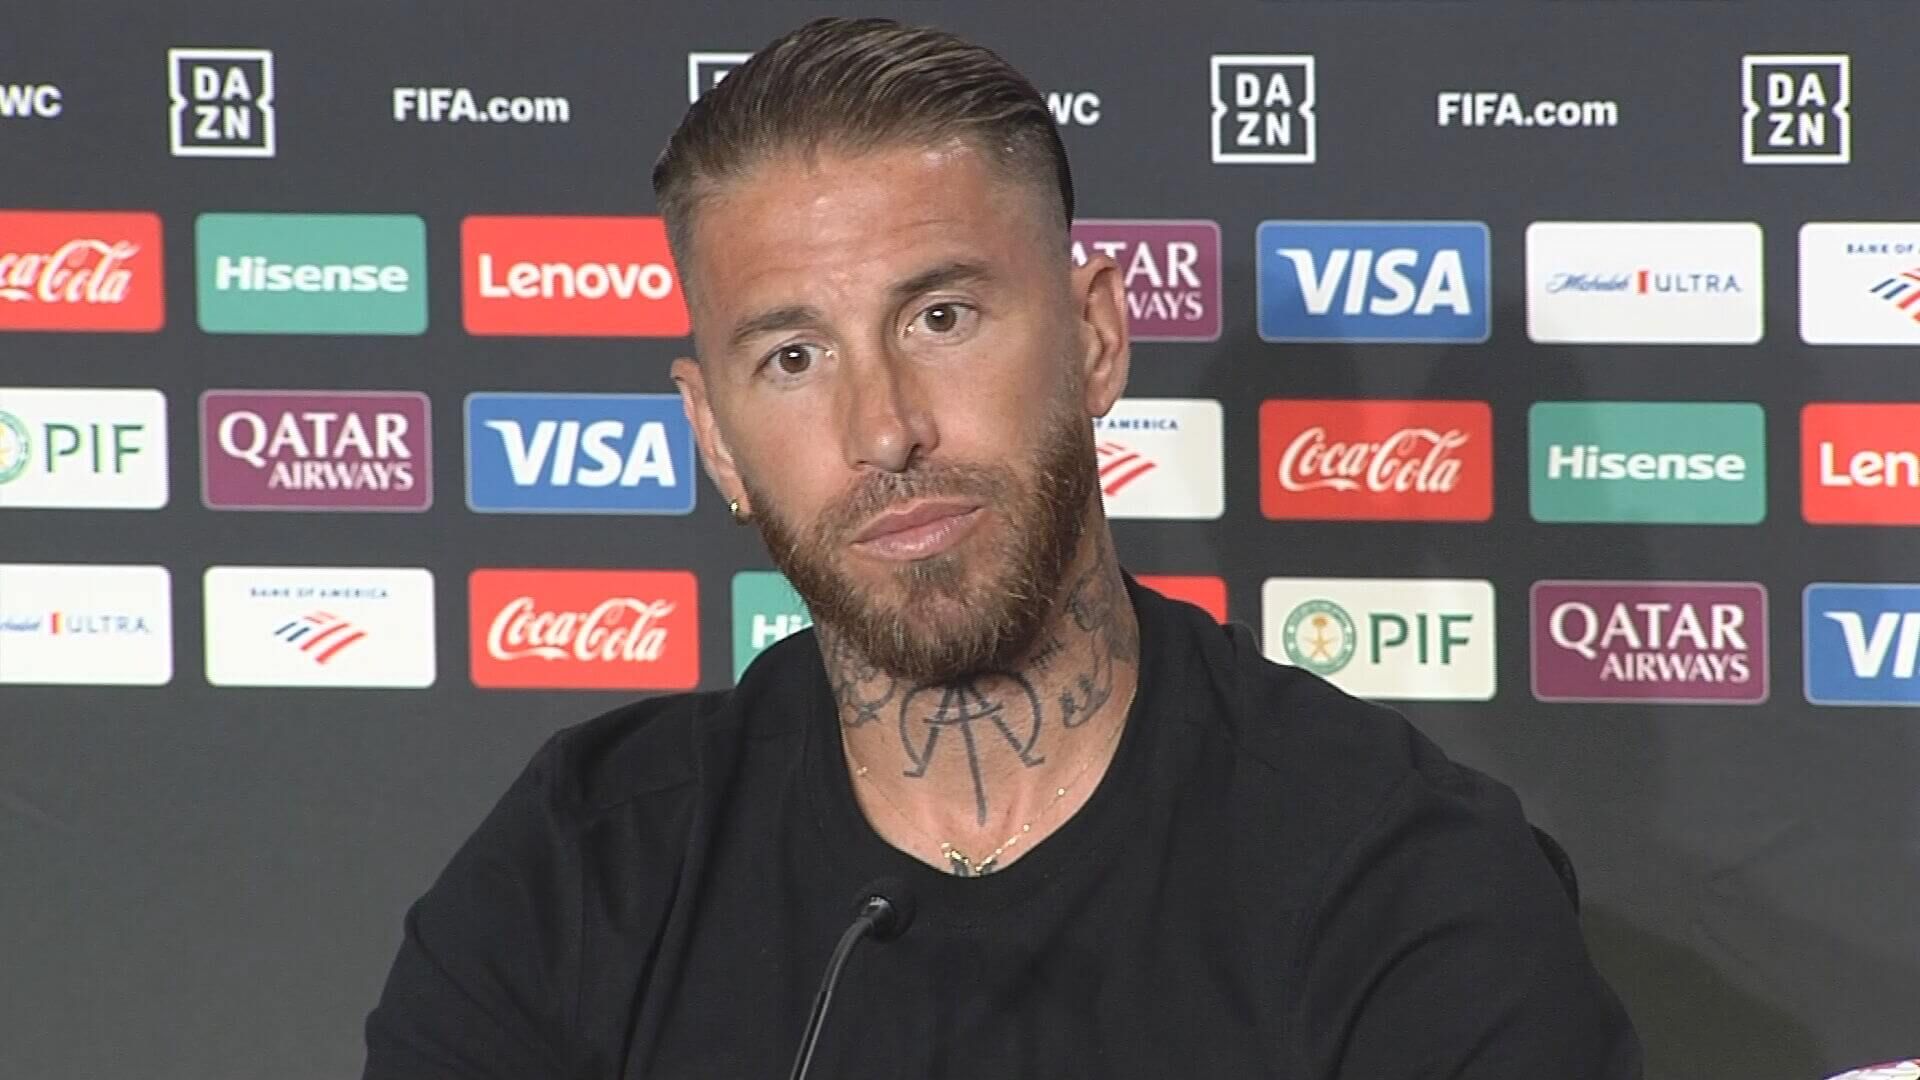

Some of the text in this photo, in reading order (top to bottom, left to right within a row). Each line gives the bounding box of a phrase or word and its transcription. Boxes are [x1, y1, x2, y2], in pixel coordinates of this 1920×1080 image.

[194, 66, 251, 102] DA
[1236, 73, 1292, 107] DA
[1768, 73, 1826, 107] DA
[196, 105, 251, 139] ZN
[393, 87, 571, 123] FIFA.com
[1438, 92, 1618, 126] FIFA.com
[1236, 111, 1292, 146] ZN
[1768, 112, 1825, 146] ZN
[216, 254, 409, 292] Hisense
[479, 253, 673, 299] Lenovo
[1276, 248, 1472, 316] VISA
[1654, 272, 1742, 293] ULTRA
[218, 411, 412, 467] QATAR
[1108, 418, 1178, 430] AMERICA
[44, 422, 145, 474] PIF
[485, 420, 677, 487] VISA
[1547, 445, 1747, 481] Hisense
[1820, 441, 1920, 488] Len
[268, 461, 415, 491] AIRWAYS
[67, 613, 153, 634] ULTRA
[1369, 612, 1474, 665] PIF
[1550, 602, 1748, 659] QATAR
[1601, 653, 1751, 683] AIRWAYS
